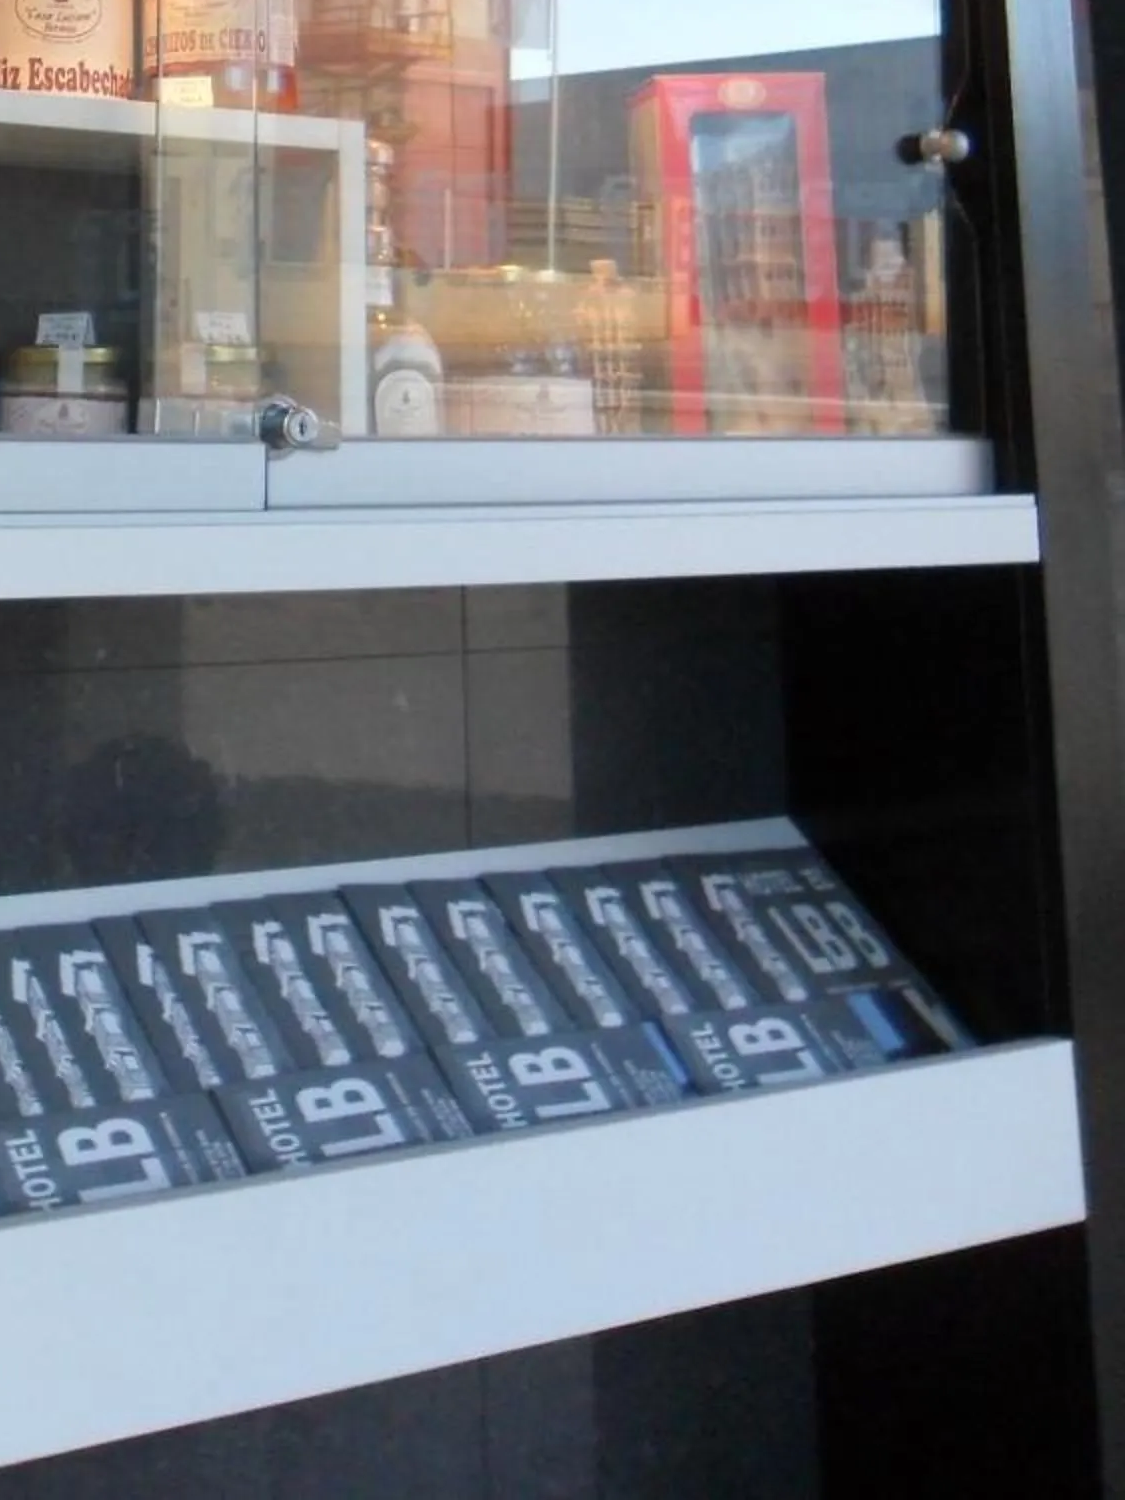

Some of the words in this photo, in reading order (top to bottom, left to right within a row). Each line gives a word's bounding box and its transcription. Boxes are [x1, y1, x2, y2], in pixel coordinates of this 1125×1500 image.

[466, 1050, 528, 1131] HOTEL
[690, 1020, 746, 1092] HOTEL
[248, 1087, 313, 1167] HOTEL
[4, 1128, 62, 1212] HOTEL
